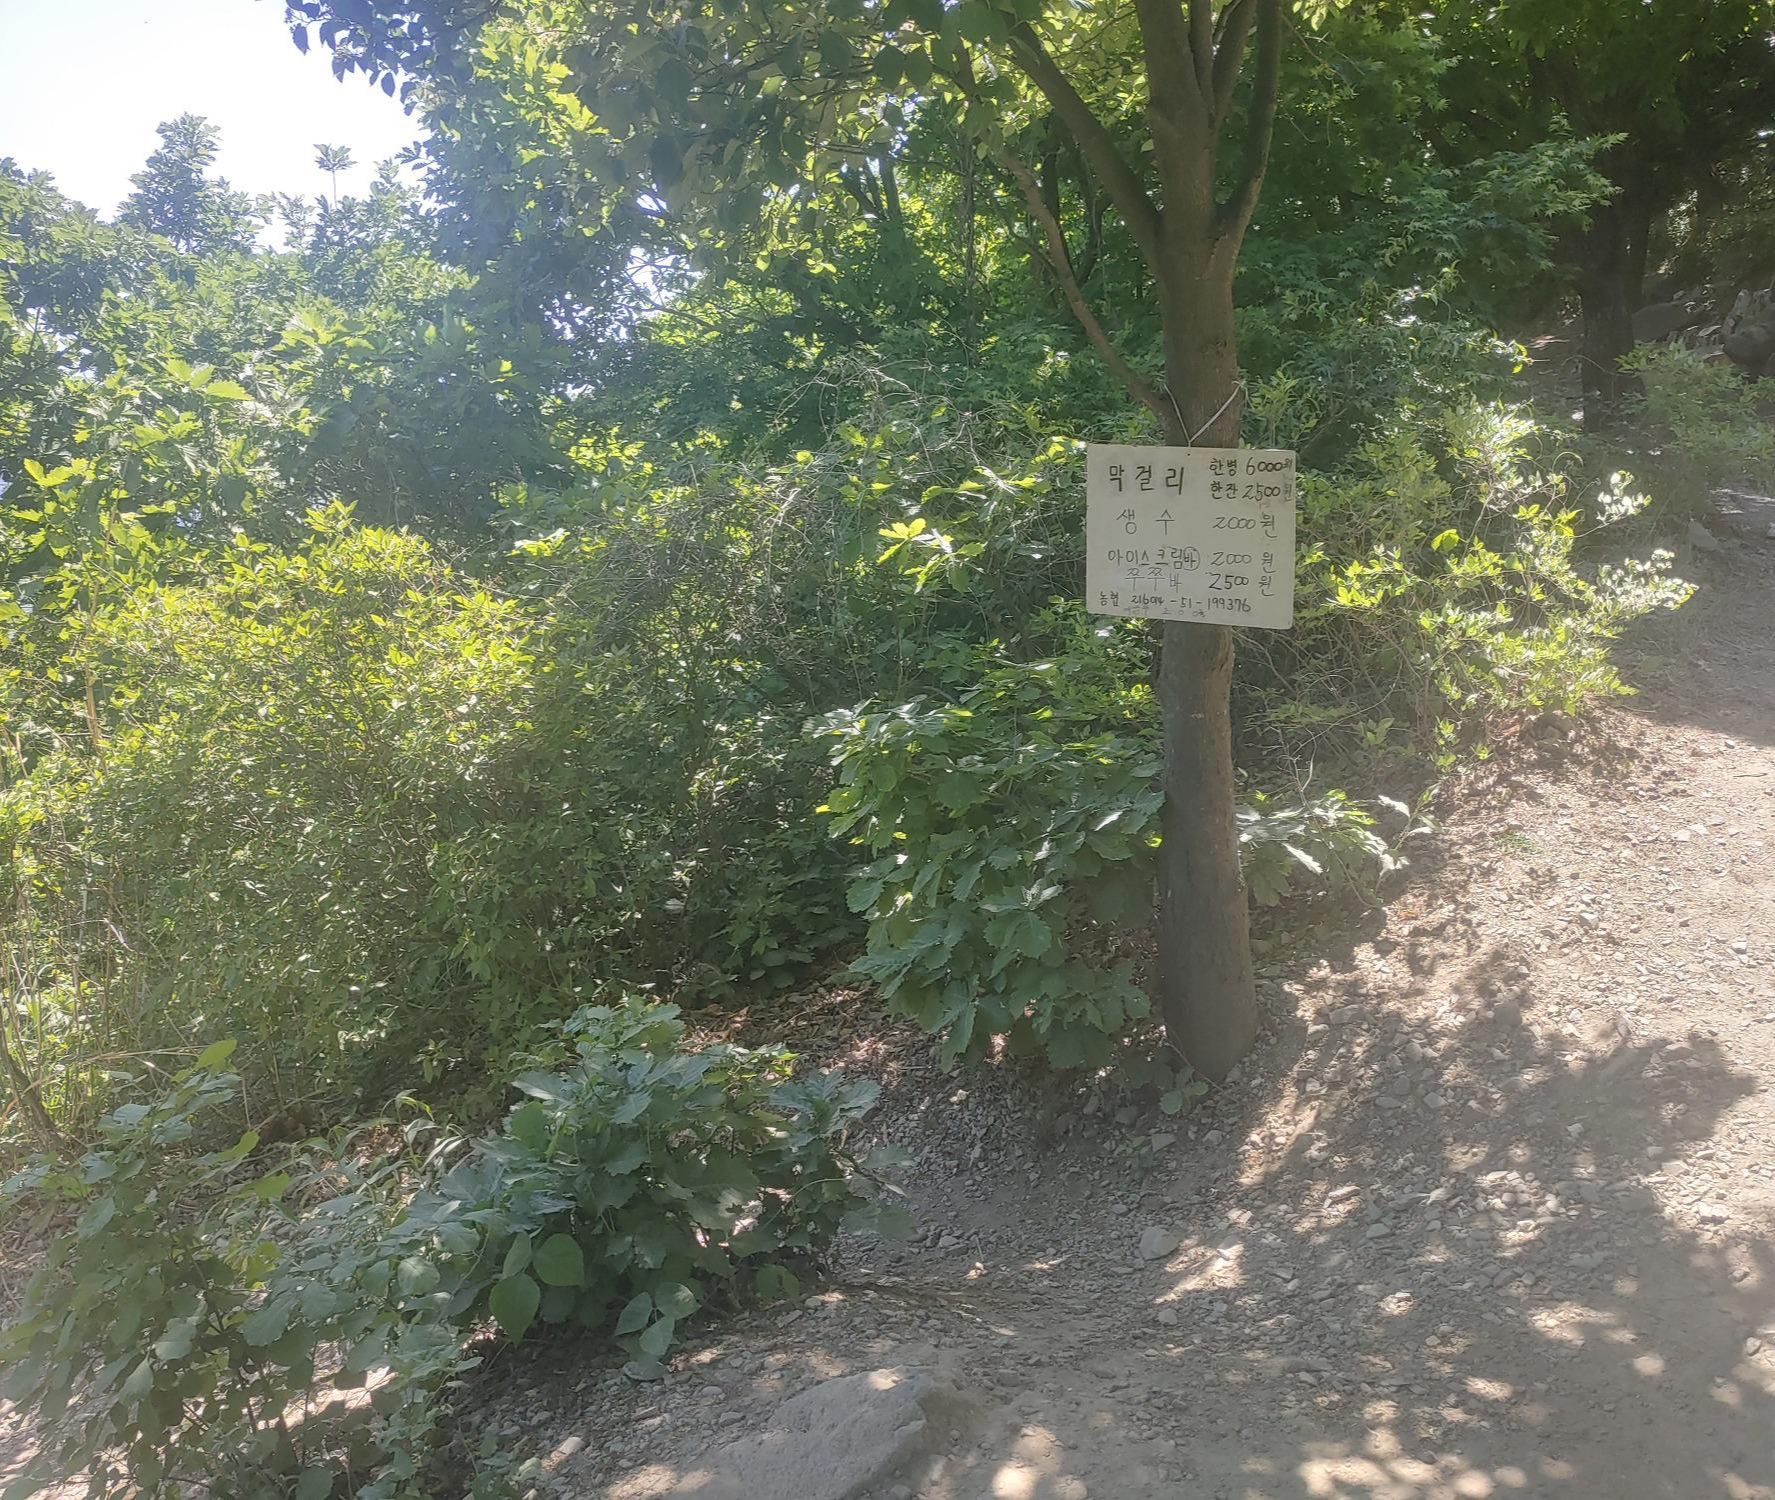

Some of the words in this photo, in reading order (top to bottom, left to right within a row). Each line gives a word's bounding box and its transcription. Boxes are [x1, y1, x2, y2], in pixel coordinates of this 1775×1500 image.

[1208, 457, 1237, 477] 한병
[1109, 464, 1184, 495] 막걸리
[1209, 480, 1239, 500] 한잔
[1124, 567, 1182, 593] 쭈쭈바
